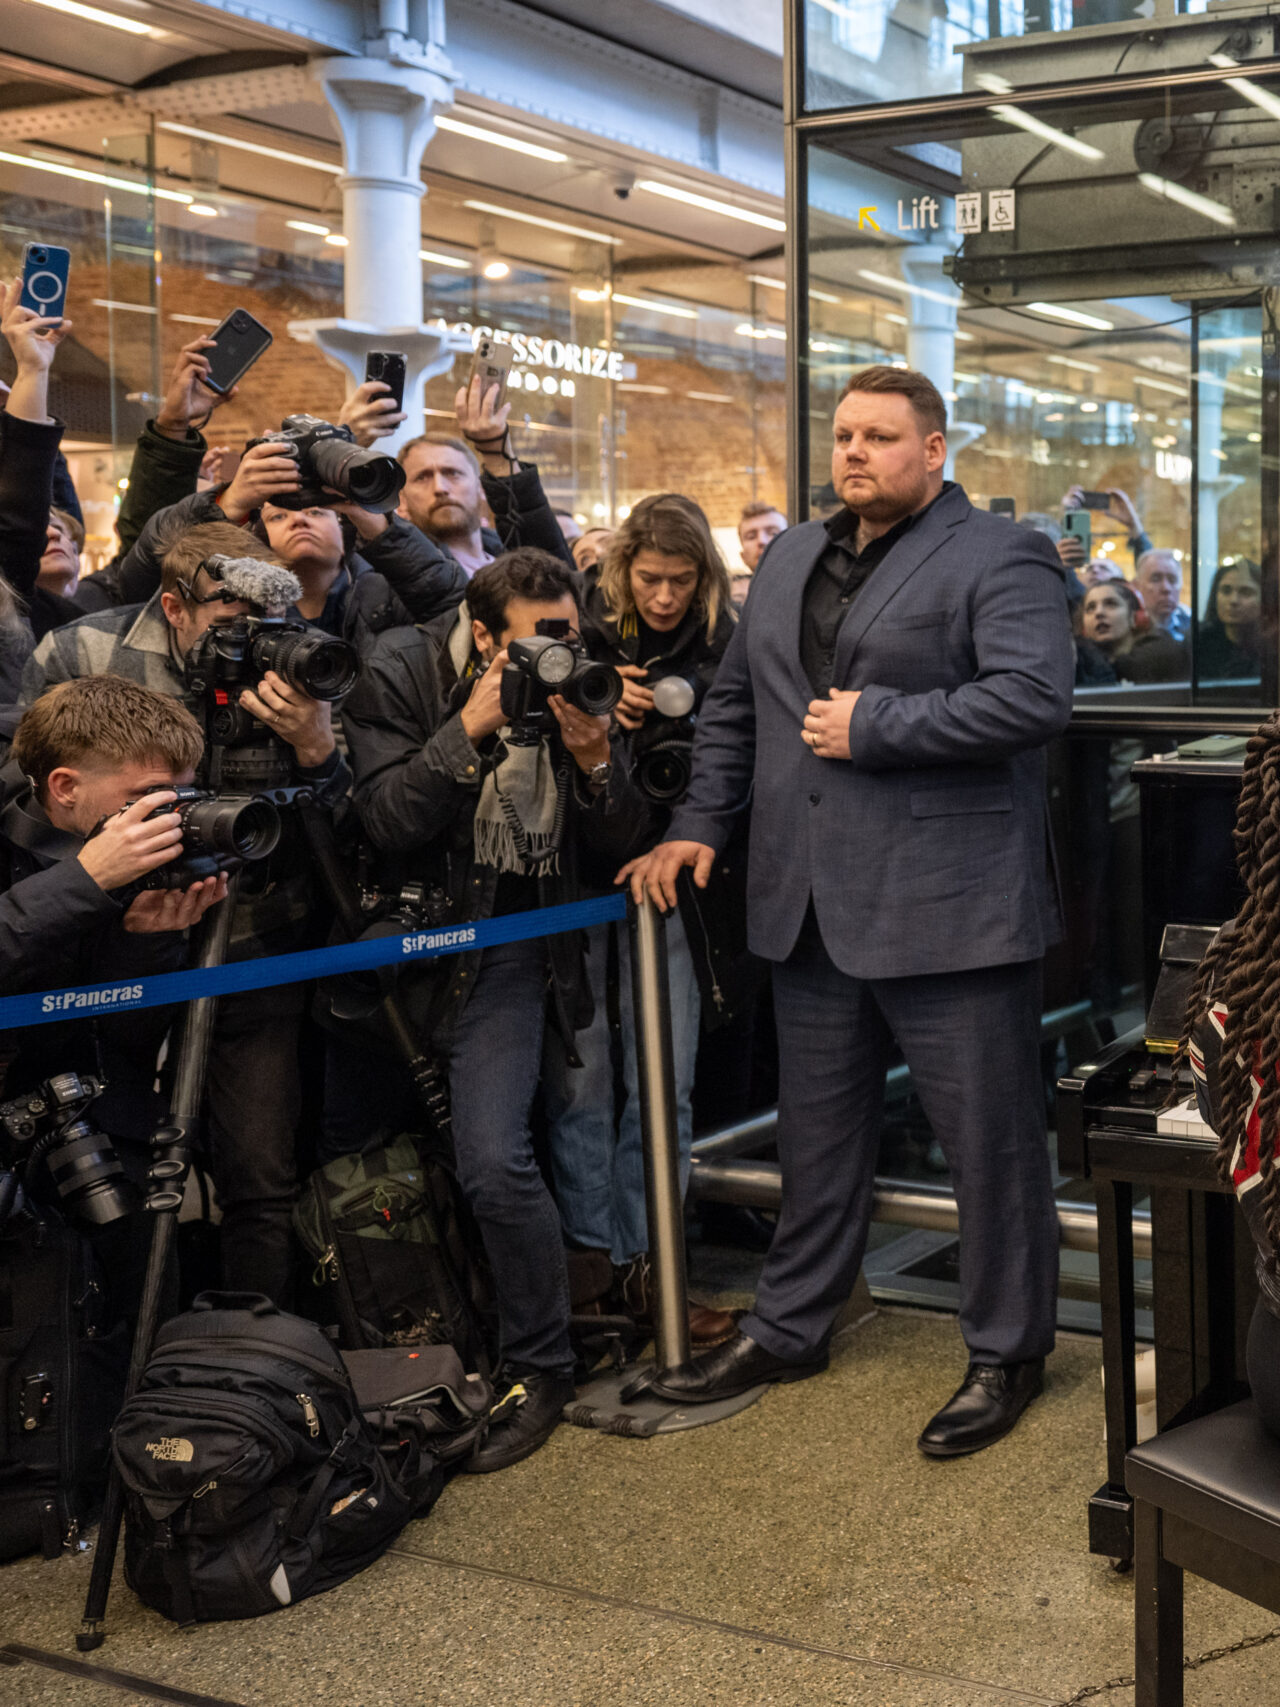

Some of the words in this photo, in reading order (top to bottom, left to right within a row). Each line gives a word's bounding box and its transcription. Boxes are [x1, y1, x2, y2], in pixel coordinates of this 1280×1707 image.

[898, 196, 939, 230] Lift
[160, 1437, 180, 1446] THE
[145, 1442, 177, 1454] NORTH
[152, 1451, 176, 1461] FACE
